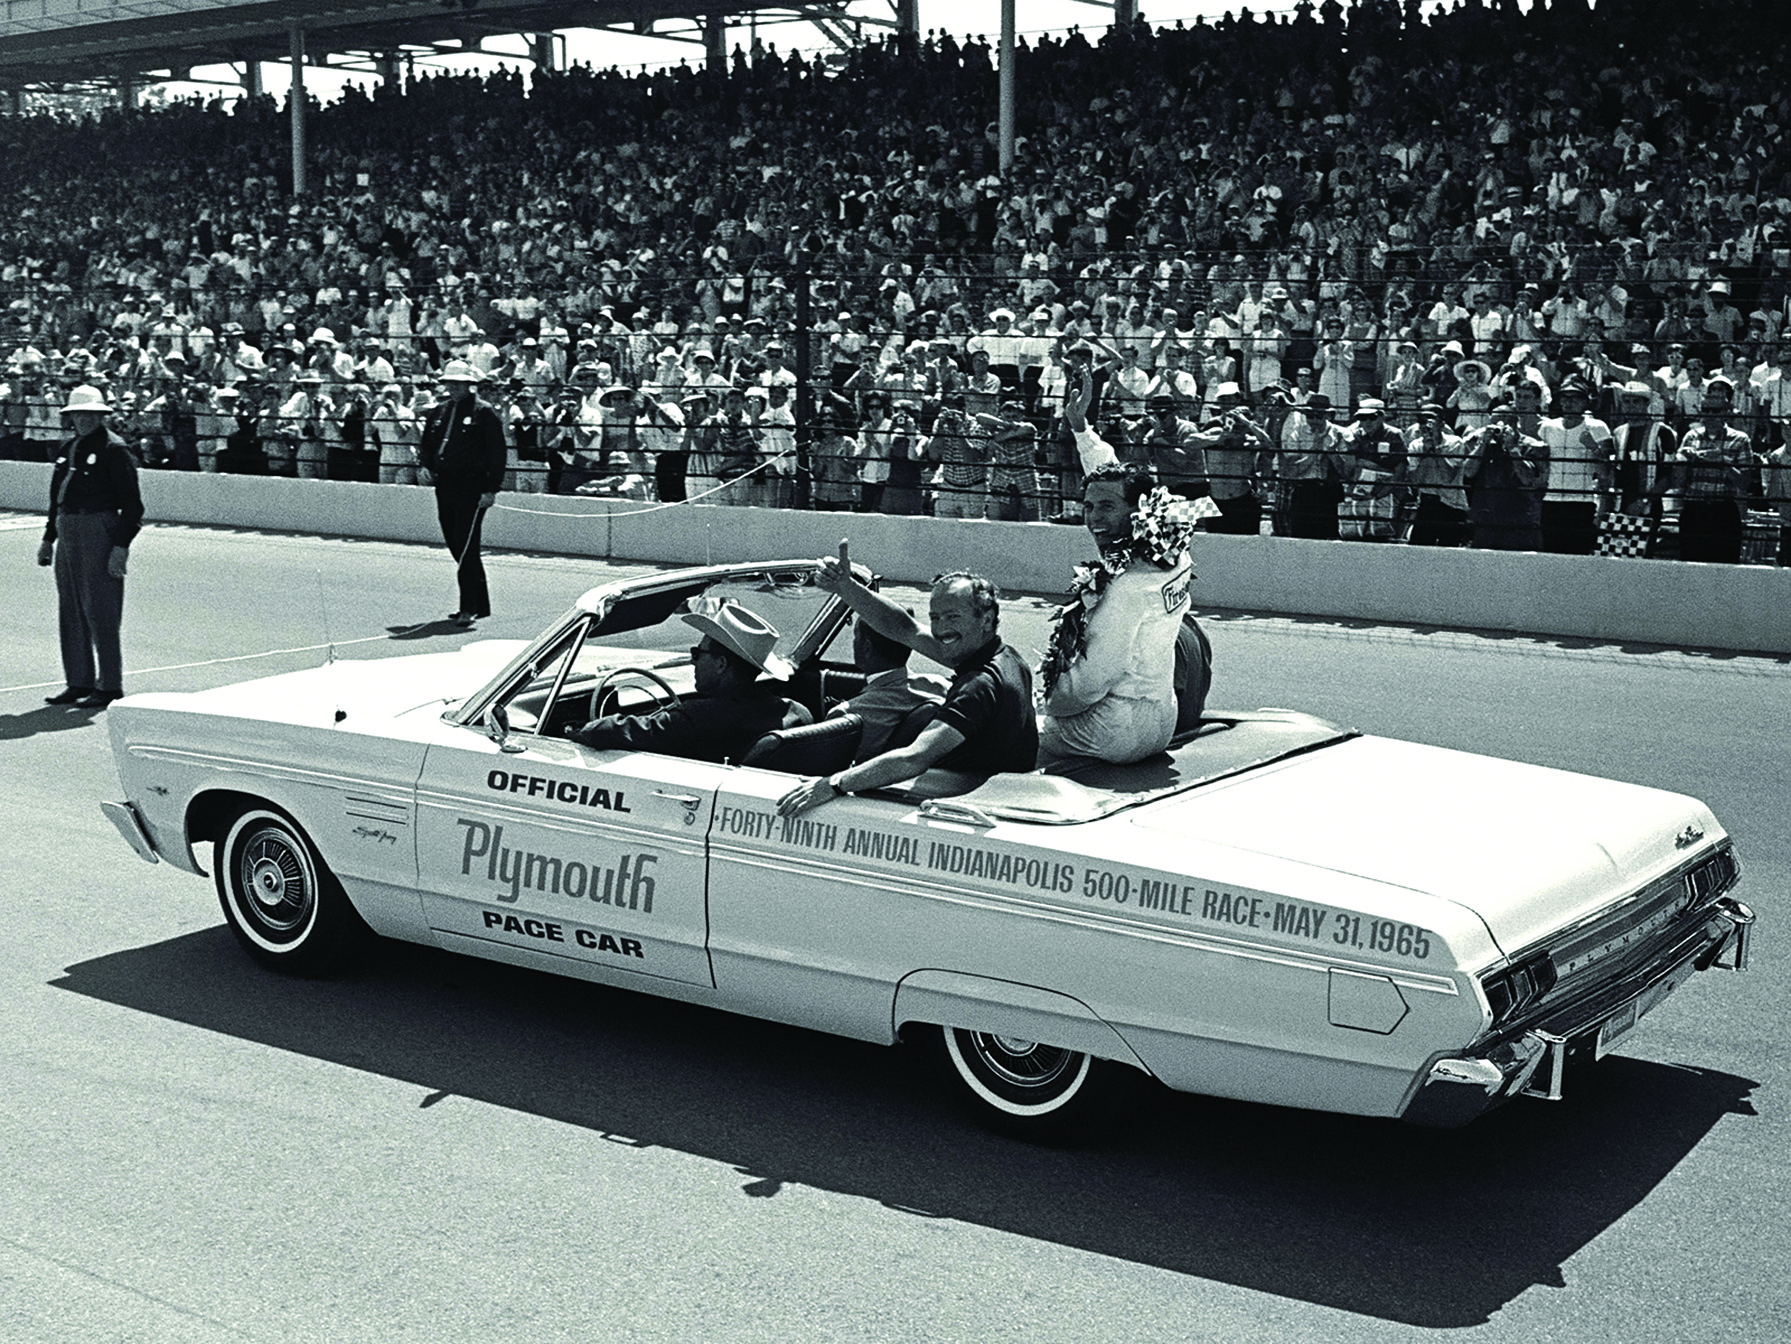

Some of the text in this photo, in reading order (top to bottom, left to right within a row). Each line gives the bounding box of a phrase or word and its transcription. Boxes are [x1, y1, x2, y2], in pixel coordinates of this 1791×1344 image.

[487, 769, 632, 814] OFFICIAL
[457, 818, 658, 914] Plymouth
[720, 806, 837, 852] FORTY-NINTH
[842, 826, 921, 867] ANNUAL
[927, 841, 1075, 894] INDIANAPOLIS
[1082, 868, 1196, 916] 500-MILE
[482, 910, 645, 959] PACE CAR
